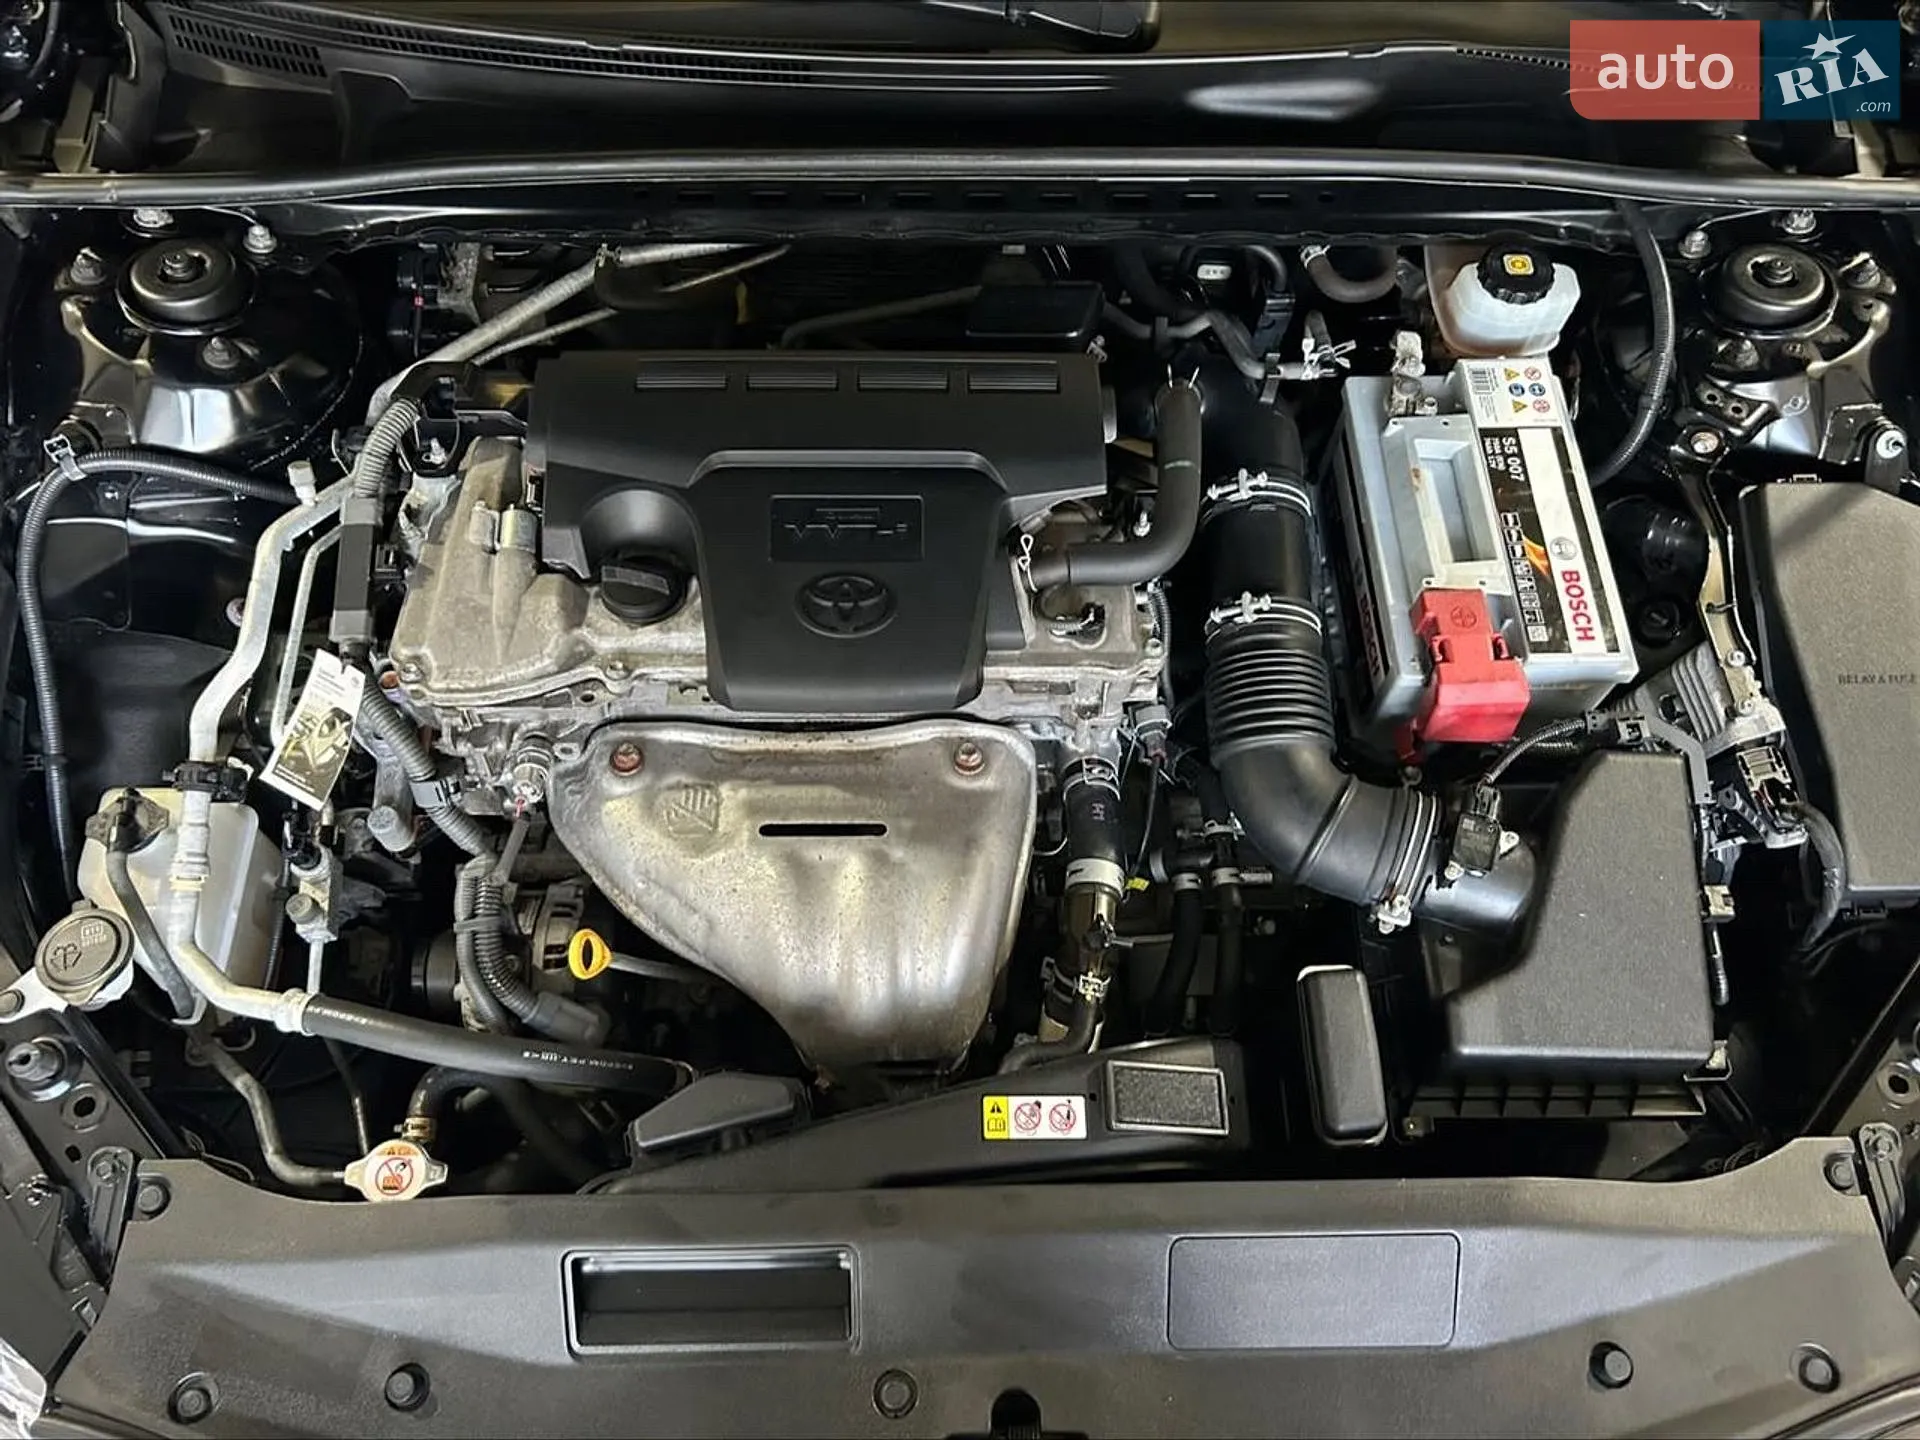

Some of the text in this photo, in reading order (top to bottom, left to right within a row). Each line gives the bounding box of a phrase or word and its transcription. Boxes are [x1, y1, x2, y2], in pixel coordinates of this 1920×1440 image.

[1502, 436, 1525, 482] S5 007
[1561, 570, 1596, 642] BOSCH
